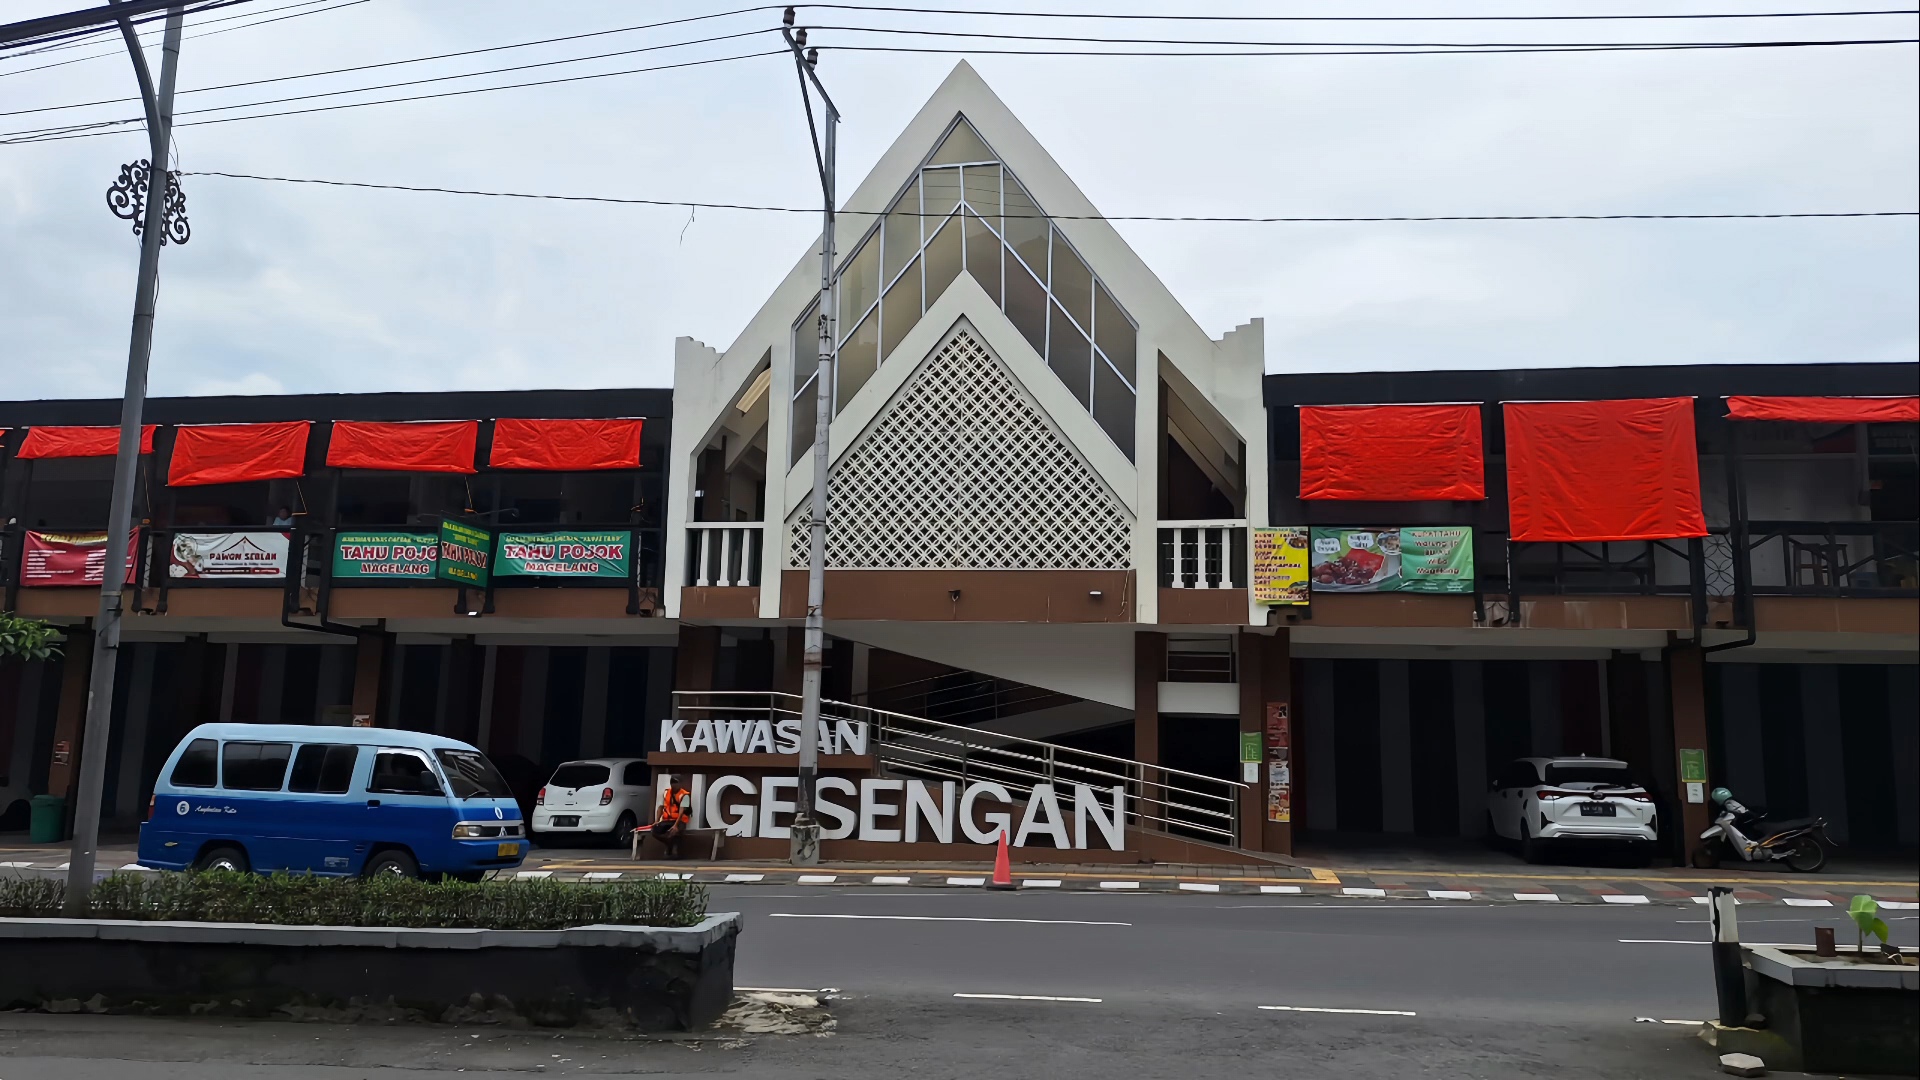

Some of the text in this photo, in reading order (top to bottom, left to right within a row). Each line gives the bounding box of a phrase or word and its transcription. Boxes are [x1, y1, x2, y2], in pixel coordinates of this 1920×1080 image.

[341, 545, 438, 561] TAHU POJO
[504, 544, 623, 560] TAHU POJOK
[360, 563, 429, 574] MAGELANG
[524, 562, 598, 572] MAGELANG
[660, 719, 867, 755] KAWASAN
